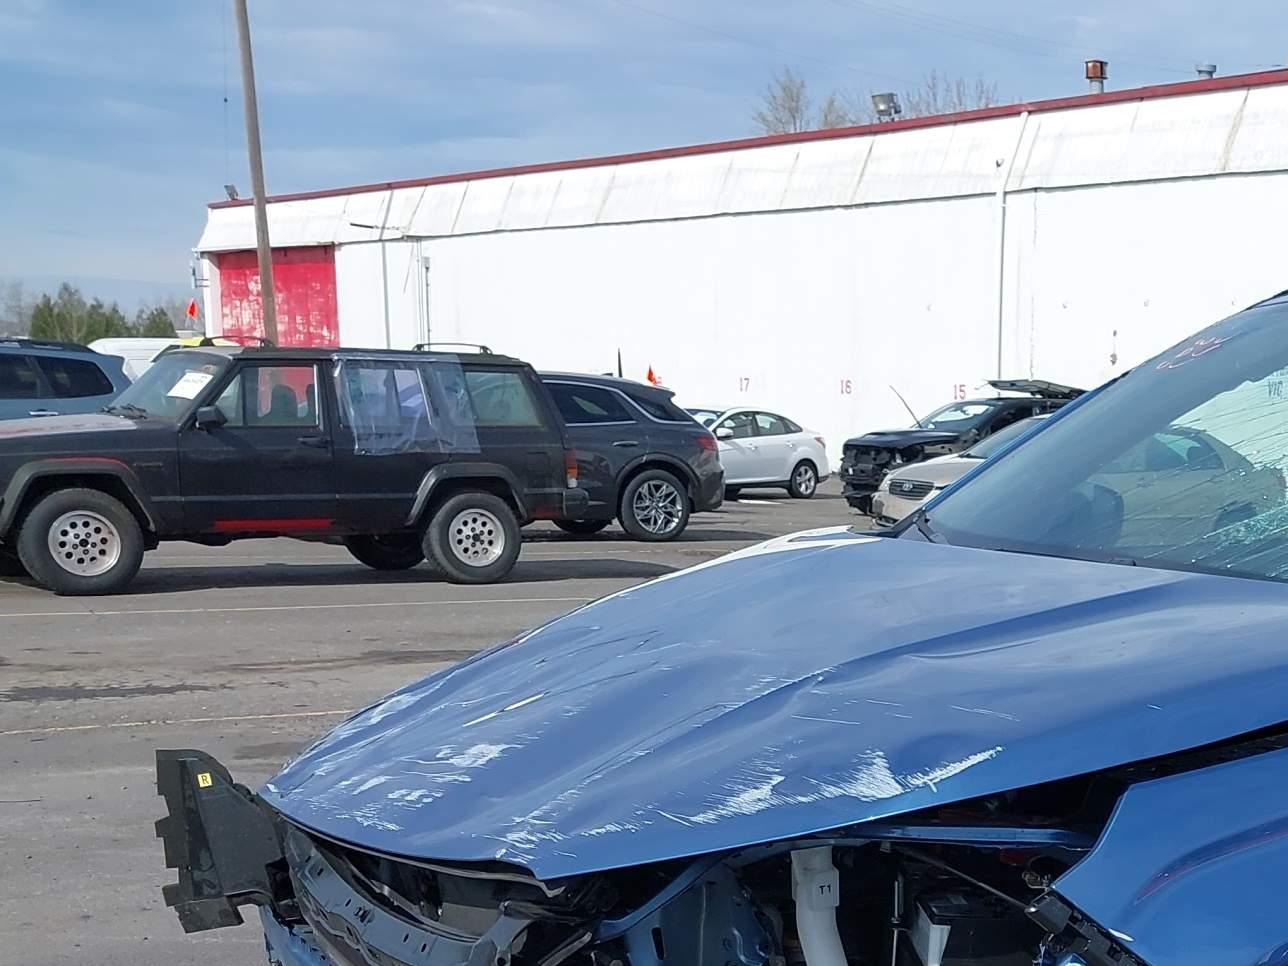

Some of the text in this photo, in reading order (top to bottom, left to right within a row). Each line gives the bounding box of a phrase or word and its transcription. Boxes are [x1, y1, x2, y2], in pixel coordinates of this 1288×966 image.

[740, 376, 750, 392] 17
[840, 379, 852, 394] 16
[954, 384, 966, 400] 15
[819, 884, 831, 895] T1
